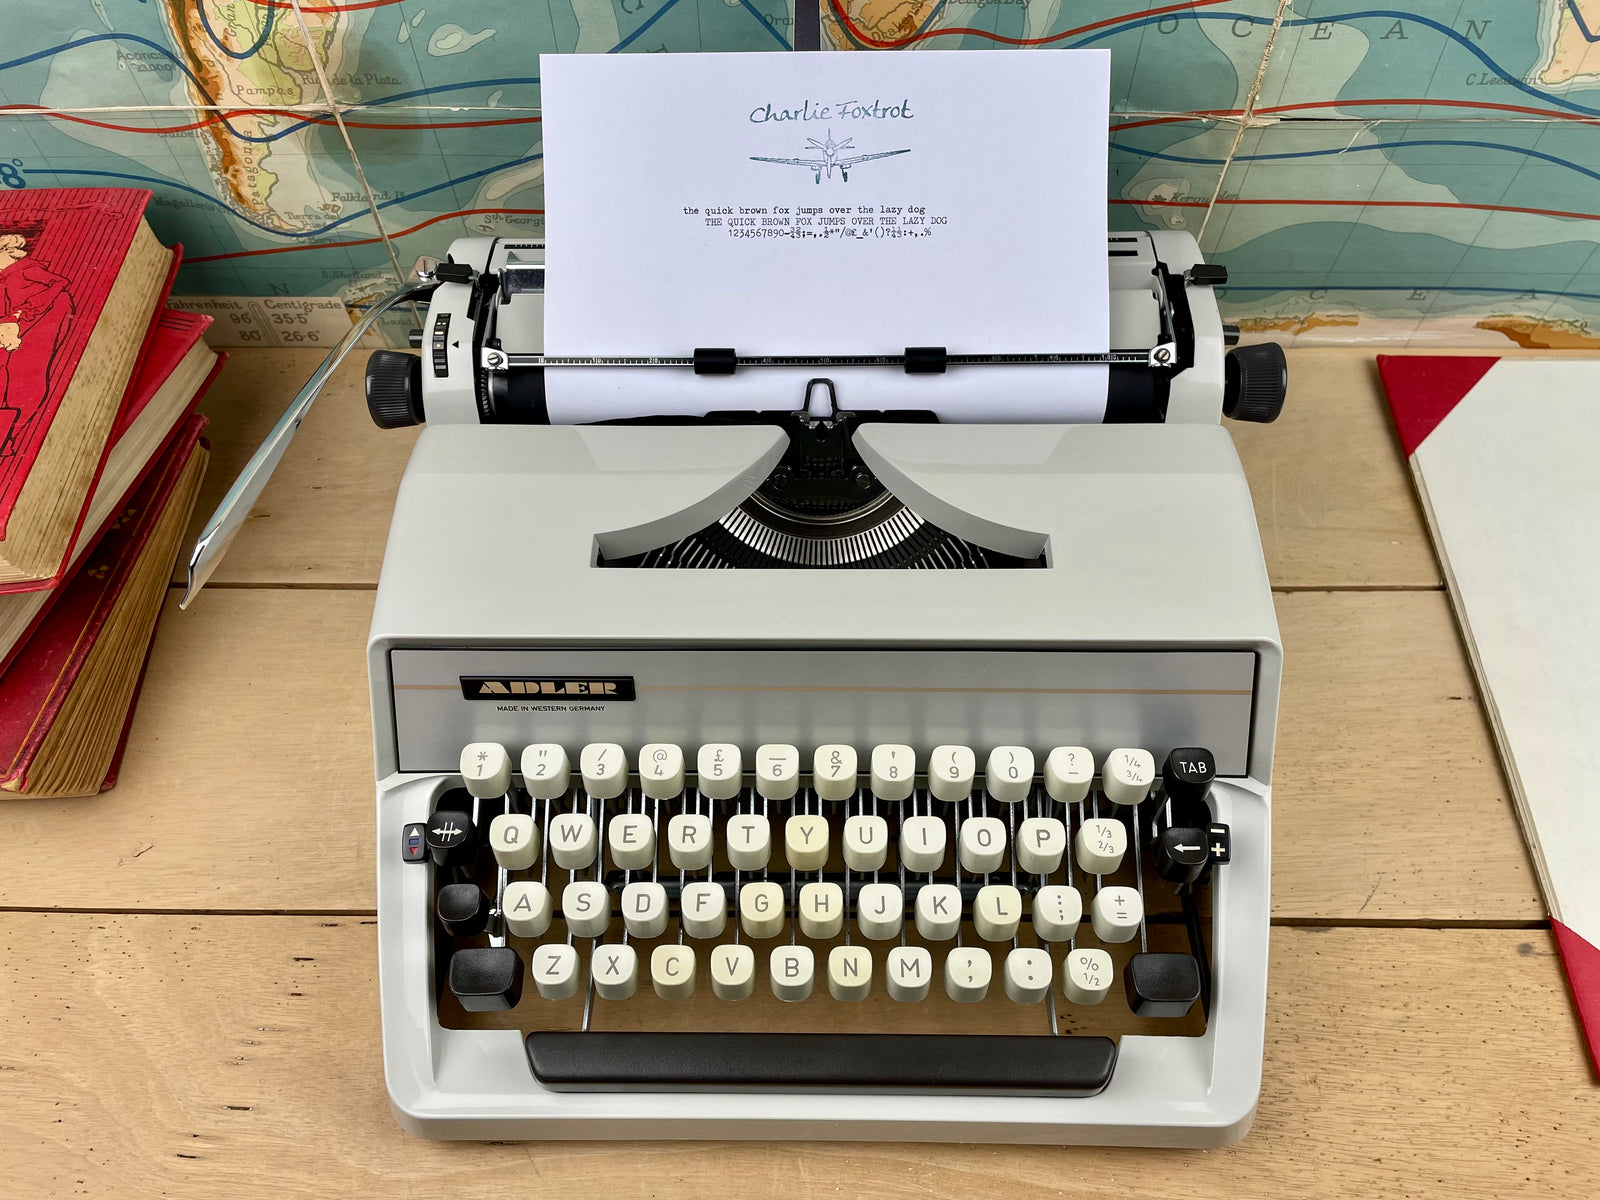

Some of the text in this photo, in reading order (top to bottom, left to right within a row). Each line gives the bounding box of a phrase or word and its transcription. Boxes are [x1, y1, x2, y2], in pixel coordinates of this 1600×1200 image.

[763, 13, 795, 26] Ora
[236, 85, 295, 97] Pampas
[749, 99, 914, 123] Charlie Foxtrot
[0, 158, 27, 189] 8°
[242, 130, 264, 206] Patagonia
[683, 206, 699, 215] the
[705, 206, 734, 216] quick
[739, 206, 768, 215] brown
[773, 206, 790, 215] fox
[796, 206, 823, 216] jumps
[858, 206, 874, 214] the
[880, 205, 903, 216] lazy
[908, 205, 926, 216] dog
[705, 217, 948, 227] THE QUICK BROWN FOX JUMPS OVER THE LAZY DOG
[263, 299, 342, 313] Centigrade
[478, 681, 619, 695] ADLER
[652, 749, 668, 763] @
[713, 749, 725, 763] £
[830, 750, 843, 765] &
[1067, 752, 1075, 767] ?
[476, 763, 483, 777] 1
[535, 763, 546, 776] 2
[596, 763, 605, 776] 3
[653, 764, 664, 777] 4
[713, 763, 723, 777] 5
[772, 764, 783, 777] 6
[830, 765, 841, 778] 7
[889, 765, 898, 779] 8
[949, 766, 960, 779] 9
[1008, 766, 1019, 779] 0
[1179, 761, 1207, 774] TAB
[503, 825, 519, 845] Q
[560, 824, 583, 843] W
[622, 825, 638, 844] E
[681, 825, 697, 844] R
[741, 825, 756, 844] T
[799, 826, 814, 845] Y
[859, 826, 873, 845] U
[922, 827, 927, 846] I
[977, 828, 992, 847] O
[1035, 829, 1051, 849] P
[512, 893, 532, 913] A
[575, 893, 592, 912] S
[635, 893, 651, 913] D
[695, 893, 711, 913] F
[754, 893, 769, 913] G
[814, 894, 829, 913] H
[874, 895, 886, 915] J
[932, 895, 948, 915] K
[996, 896, 1009, 916] L
[545, 955, 562, 976] Z
[605, 955, 620, 976] X
[665, 956, 680, 977] C
[725, 956, 740, 977] V
[785, 957, 800, 978] B
[843, 957, 858, 977] N
[900, 958, 920, 978] M
[1079, 956, 1099, 971] %
